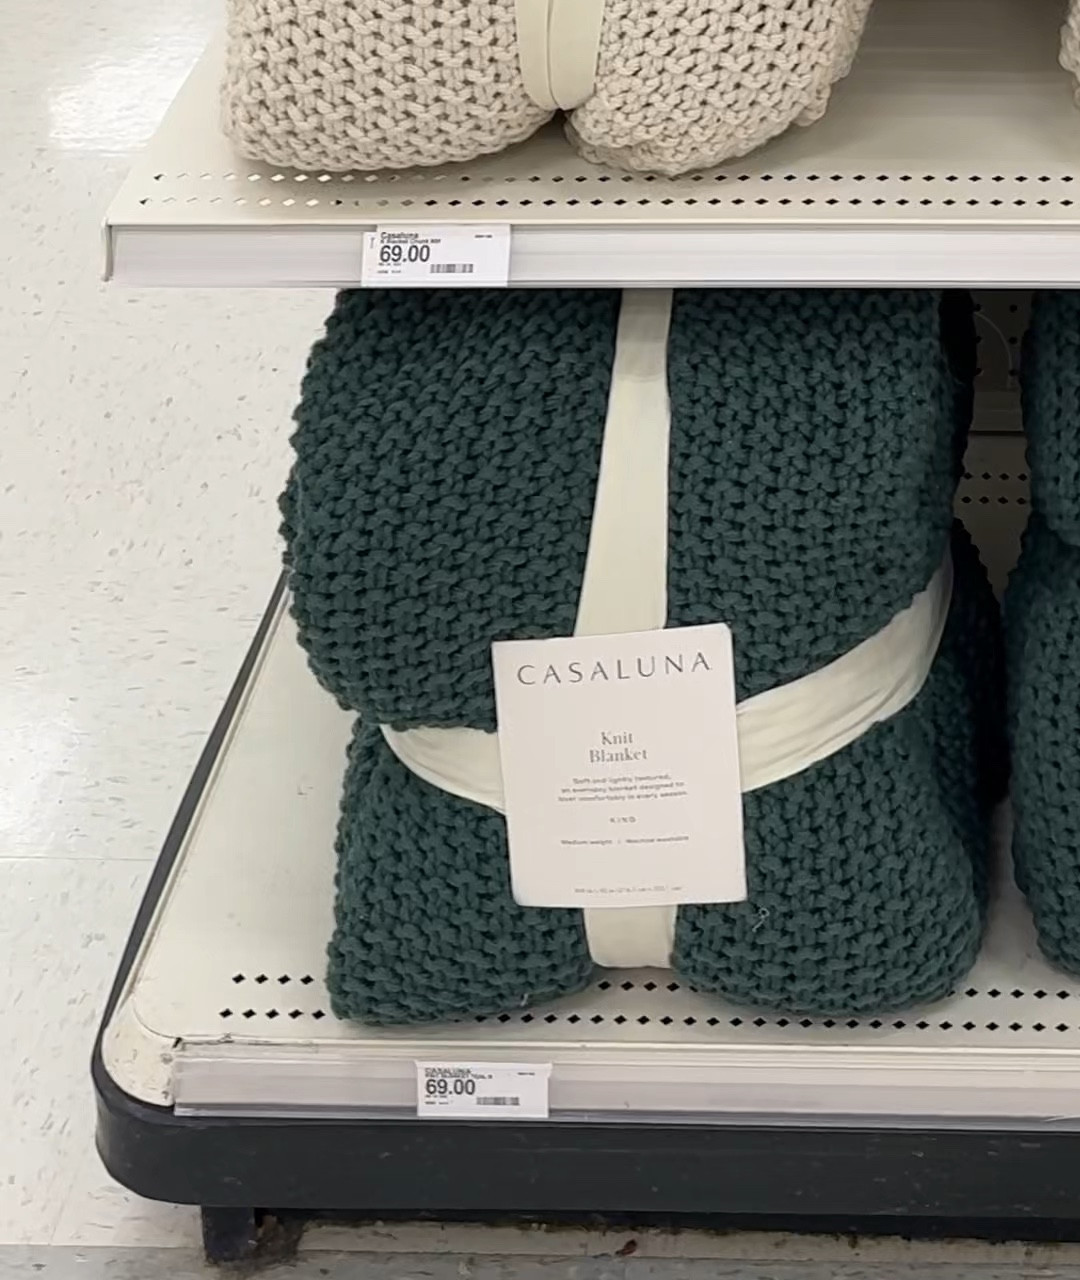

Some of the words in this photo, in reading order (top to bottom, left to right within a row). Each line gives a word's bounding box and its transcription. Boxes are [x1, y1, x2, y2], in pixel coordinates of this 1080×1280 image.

[380, 245, 430, 262] 69.00
[517, 652, 711, 685] CASALUNA
[601, 732, 633, 745] Knit
[590, 748, 647, 763] Blanket
[426, 1079, 476, 1095] 69.00
